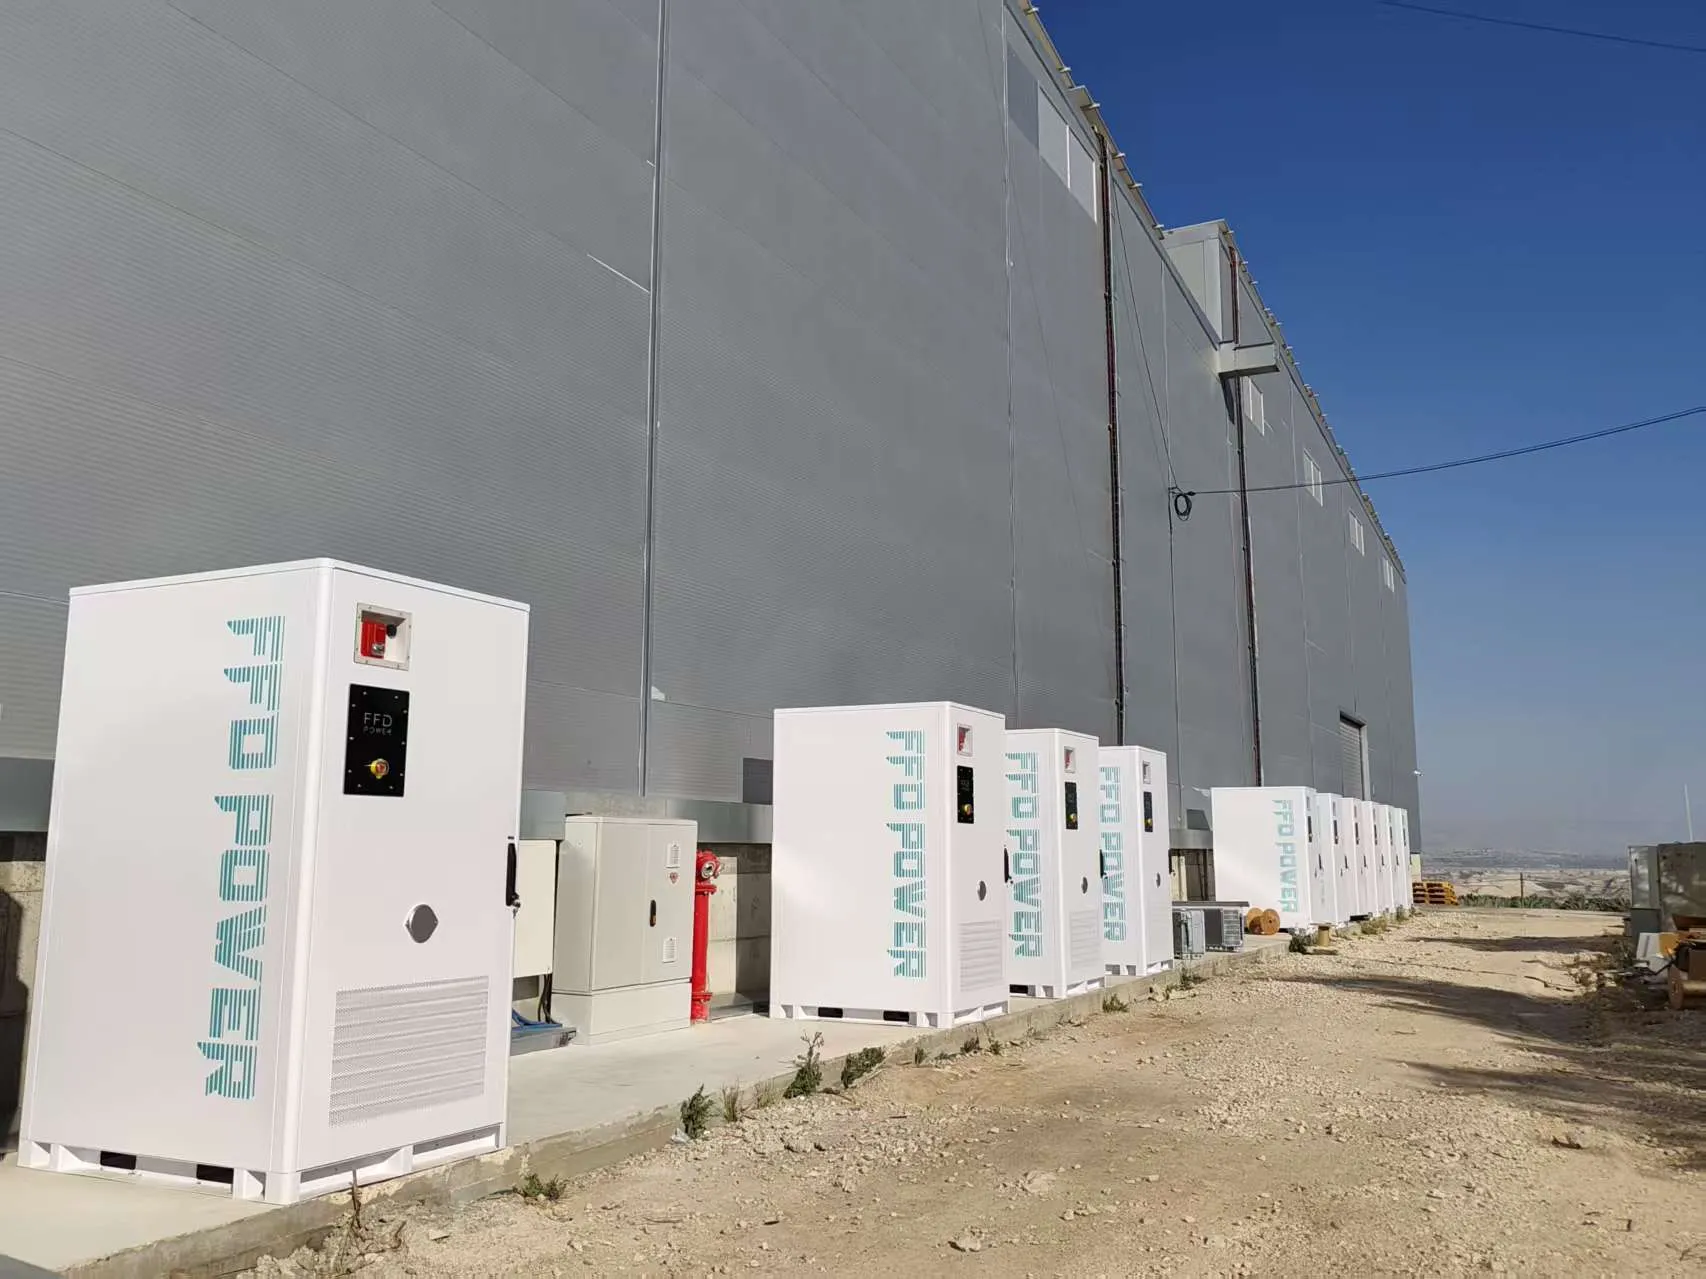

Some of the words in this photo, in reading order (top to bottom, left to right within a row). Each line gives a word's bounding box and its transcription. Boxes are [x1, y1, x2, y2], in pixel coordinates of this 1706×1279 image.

[223, 615, 285, 770] FFD
[363, 712, 393, 727] FFD
[886, 822, 926, 978] POWER
[1006, 829, 1043, 957] POWER
[1101, 832, 1126, 941] POWER
[1275, 842, 1298, 912] POWER
[196, 794, 273, 1100] POWER
